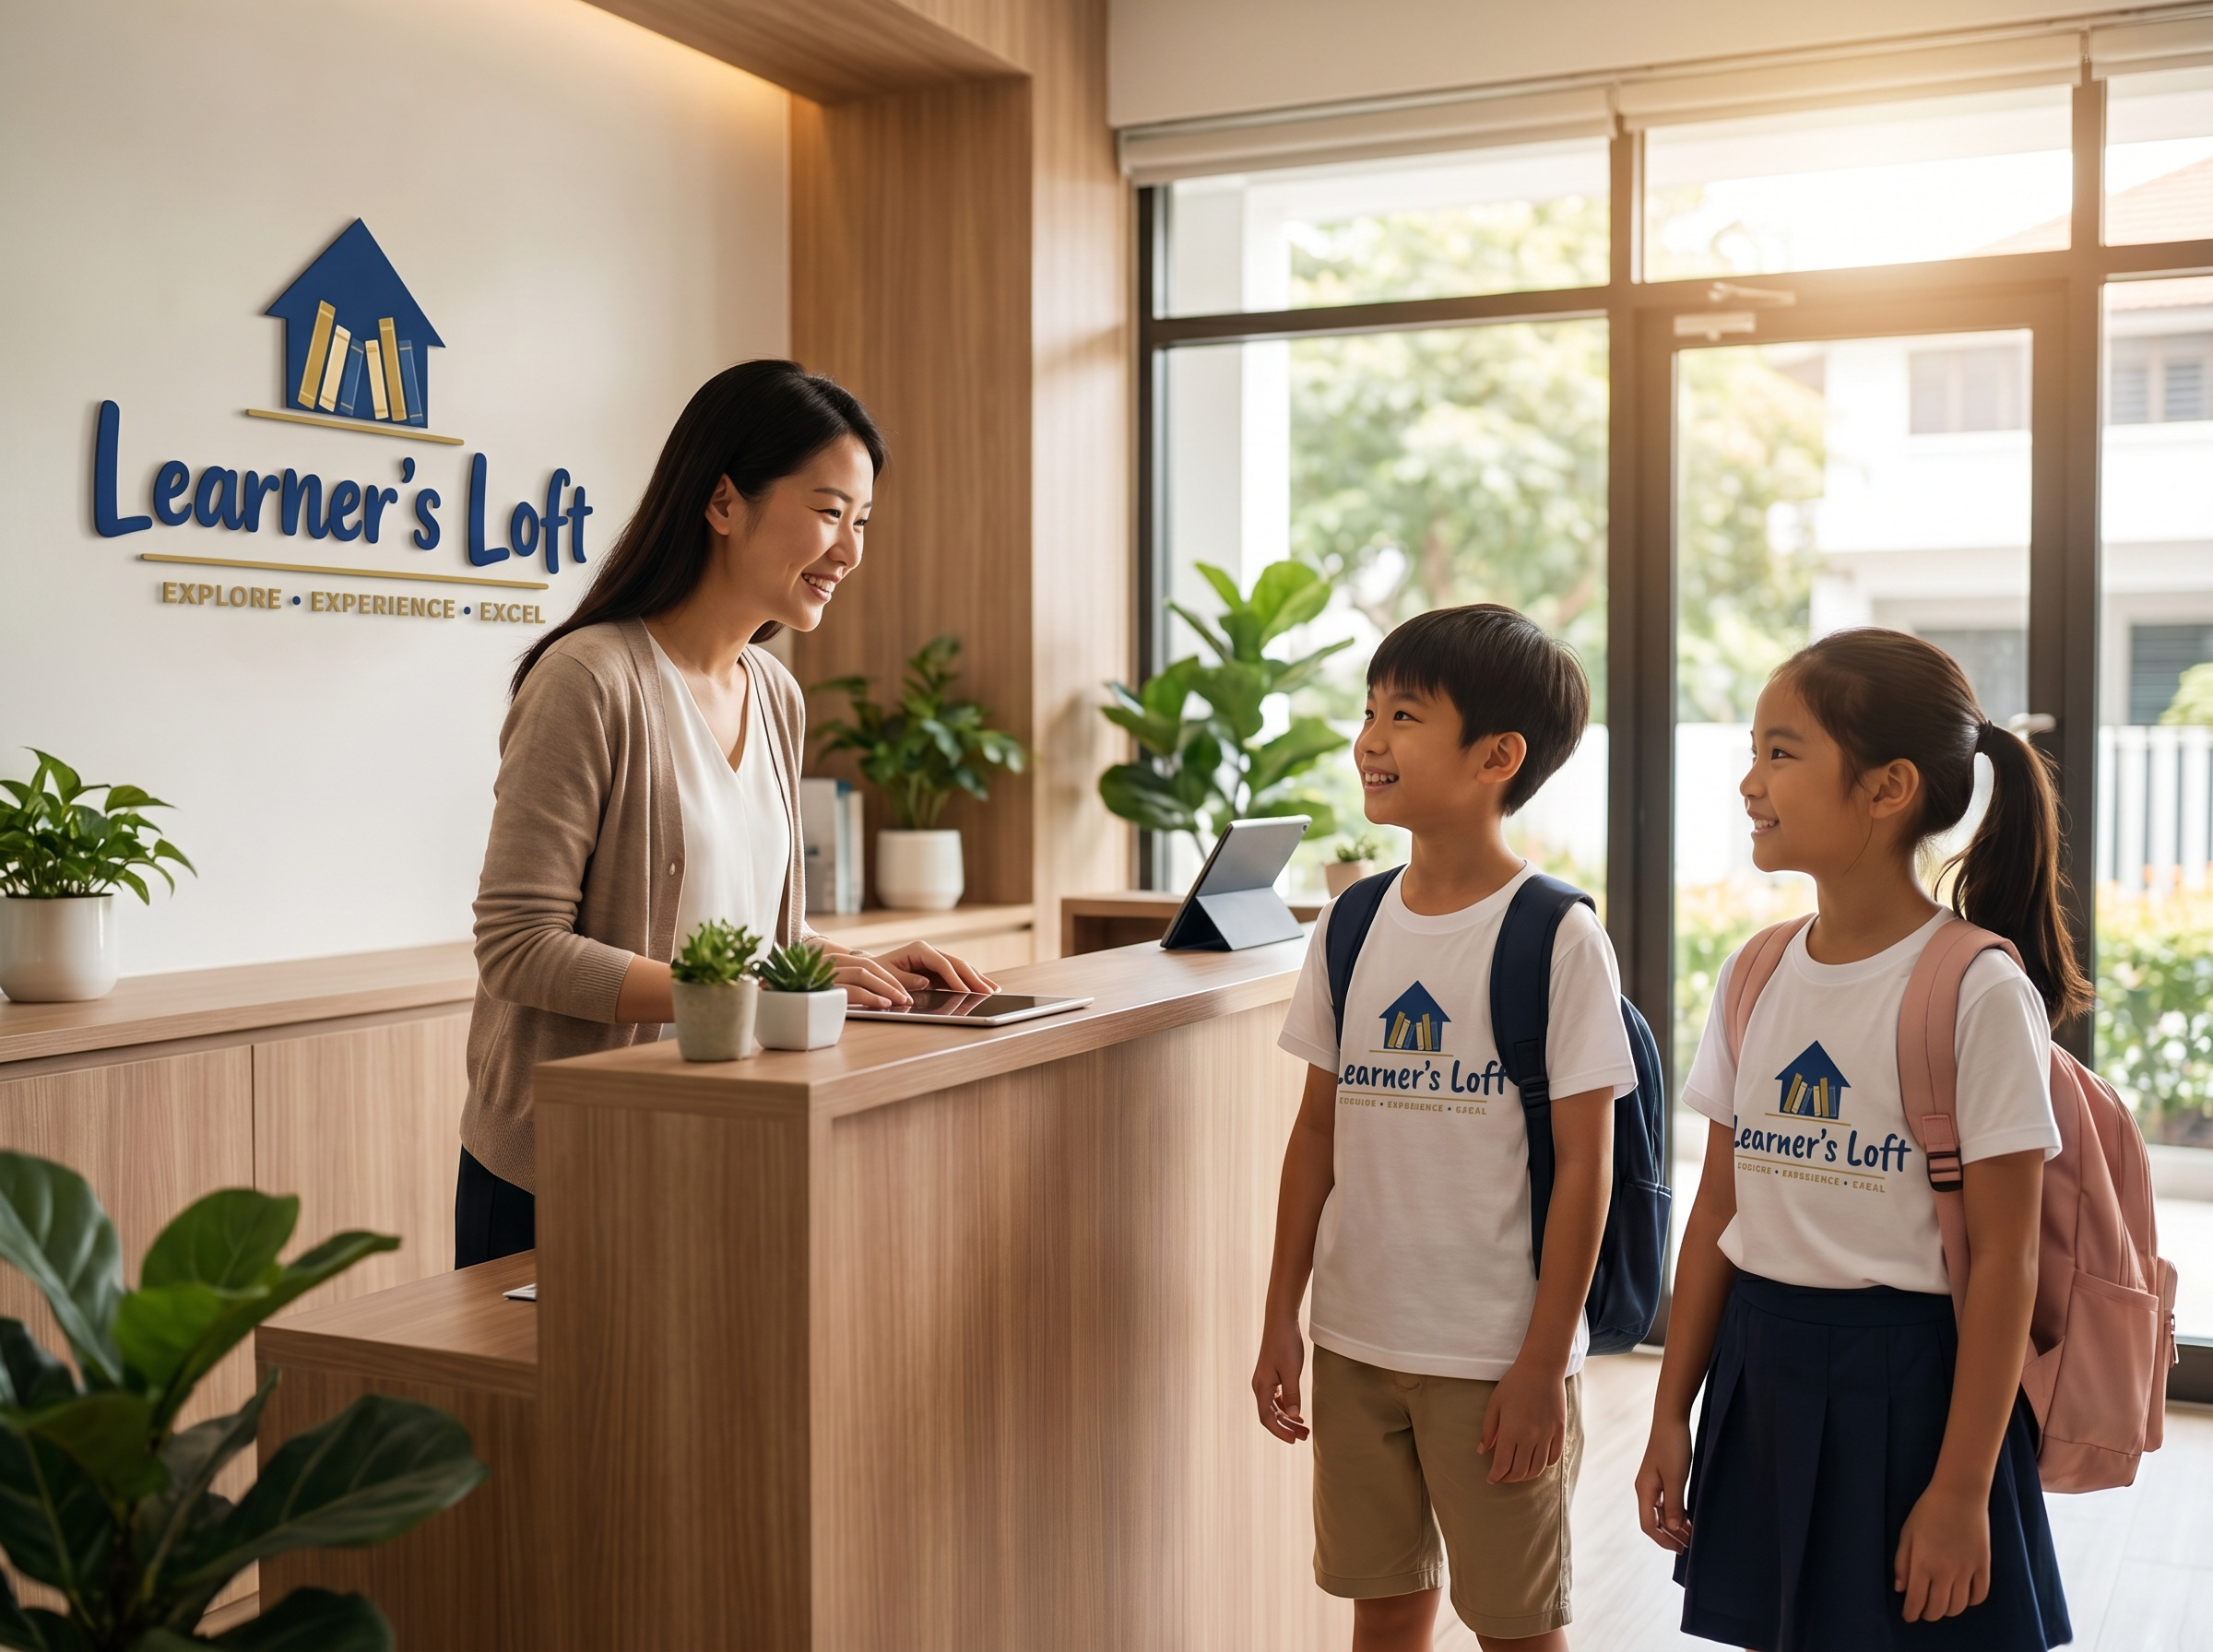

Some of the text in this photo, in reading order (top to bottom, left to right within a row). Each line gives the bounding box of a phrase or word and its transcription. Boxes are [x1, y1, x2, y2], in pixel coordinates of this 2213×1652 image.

[94, 399, 594, 575] Learner's Loft
[162, 581, 546, 625] EXPLORE EXPERIENCE EXCEL
[1338, 1059, 1509, 1095] earner's Loft
[1847, 1129, 1912, 1173] Loft
